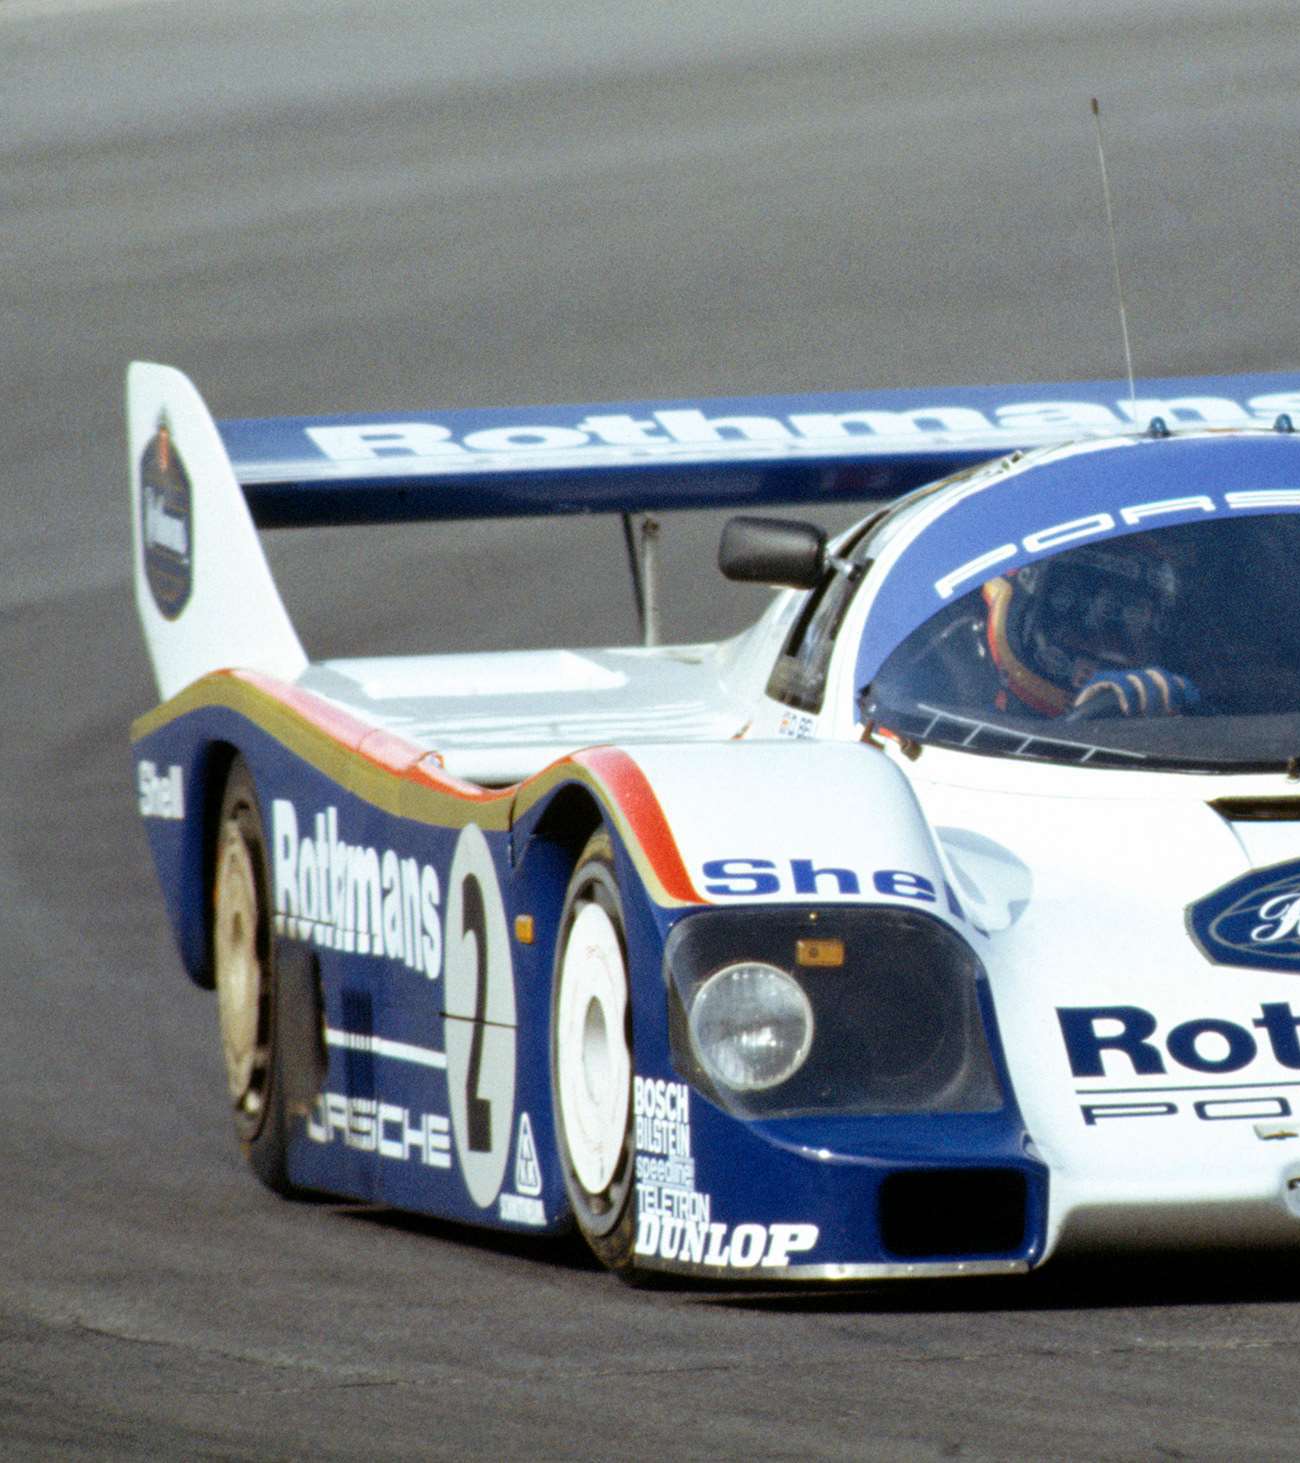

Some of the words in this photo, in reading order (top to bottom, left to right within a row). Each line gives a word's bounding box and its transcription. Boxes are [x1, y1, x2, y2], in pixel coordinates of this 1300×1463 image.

[272, 800, 443, 980] Rothmans
[702, 858, 962, 921] She
[462, 873, 492, 1153] 2
[634, 1075, 689, 1123] BOSCH
[635, 1117, 691, 1158] BILSTEIN
[636, 1183, 711, 1226] TELETRON
[635, 1213, 819, 1268] DUNLOP
